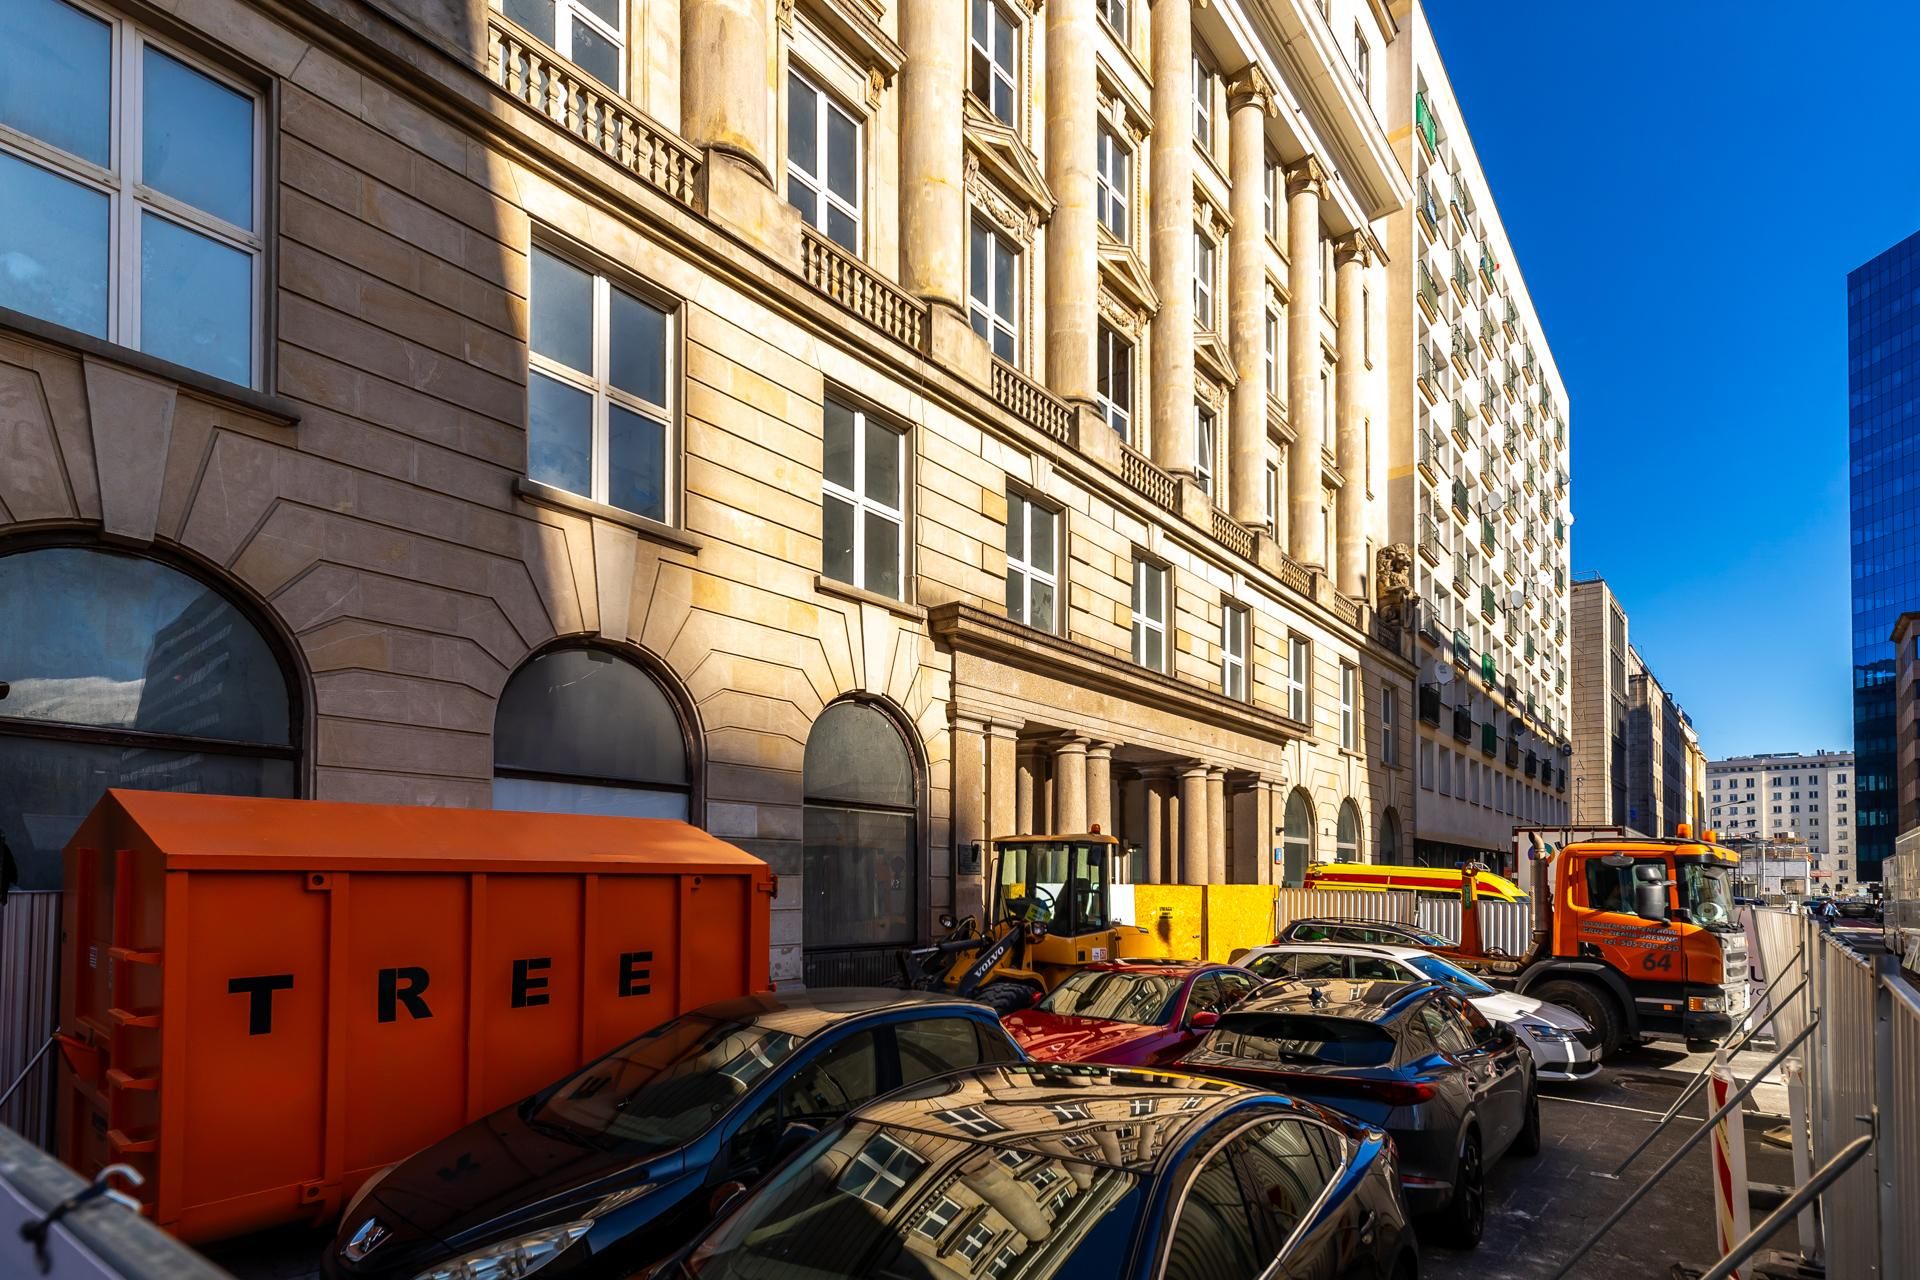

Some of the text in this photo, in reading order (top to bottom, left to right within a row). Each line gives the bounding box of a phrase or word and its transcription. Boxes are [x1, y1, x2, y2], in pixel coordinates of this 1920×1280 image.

[974, 946, 1004, 977] VOLVO
[1643, 953, 1672, 972] 64
[228, 951, 653, 1035] TREE
